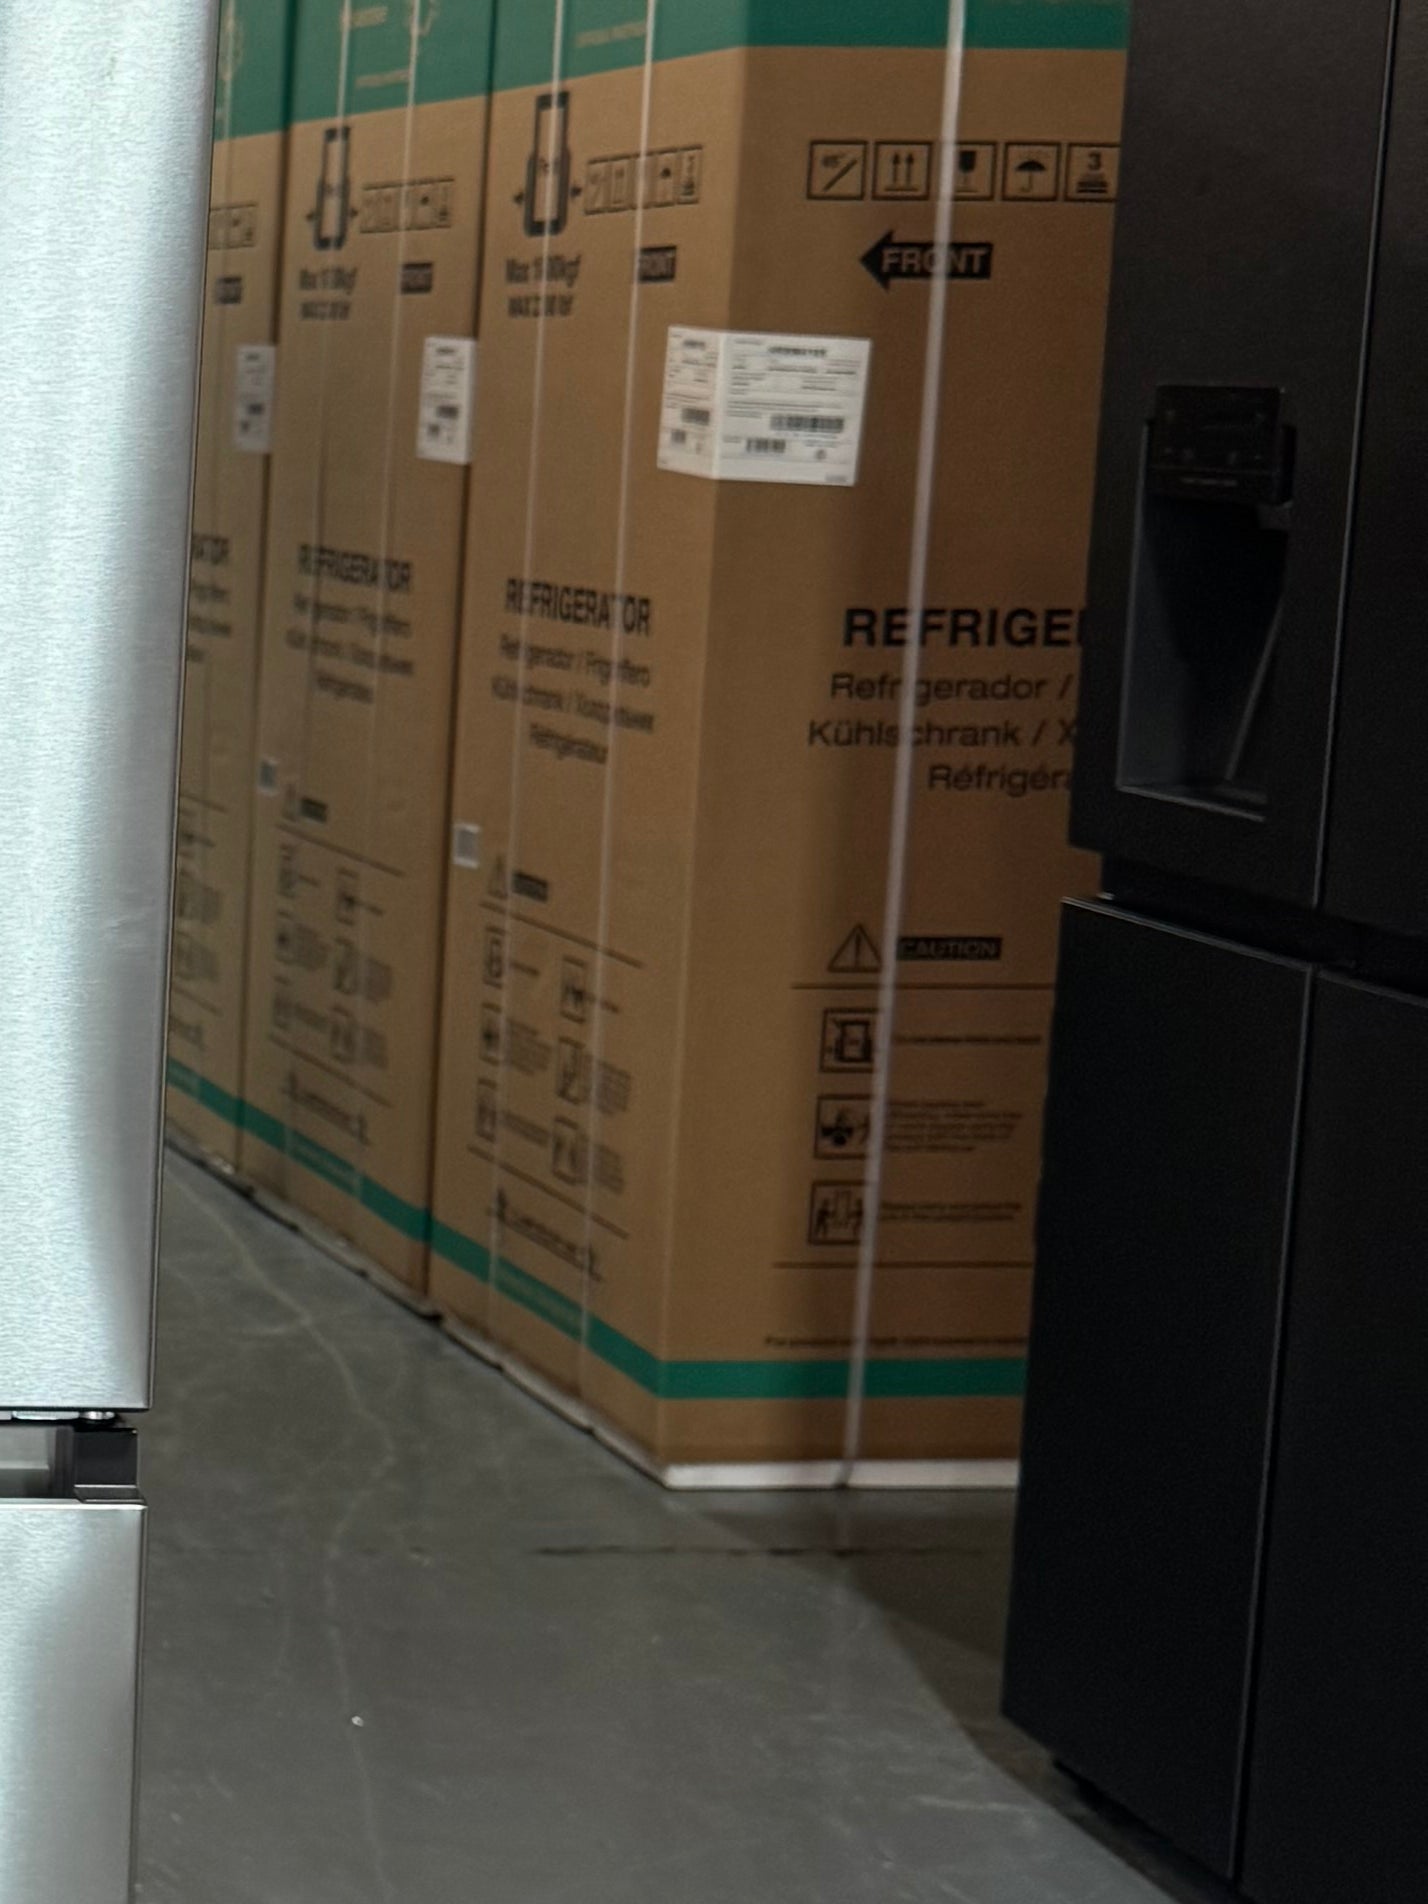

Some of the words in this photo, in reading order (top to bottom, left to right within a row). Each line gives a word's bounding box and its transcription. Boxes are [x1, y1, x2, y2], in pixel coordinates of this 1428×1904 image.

[844, 608, 1086, 647] REFRIGE
[830, 672, 1048, 707] Refrgerador
[927, 764, 1072, 798] Réfrigér
